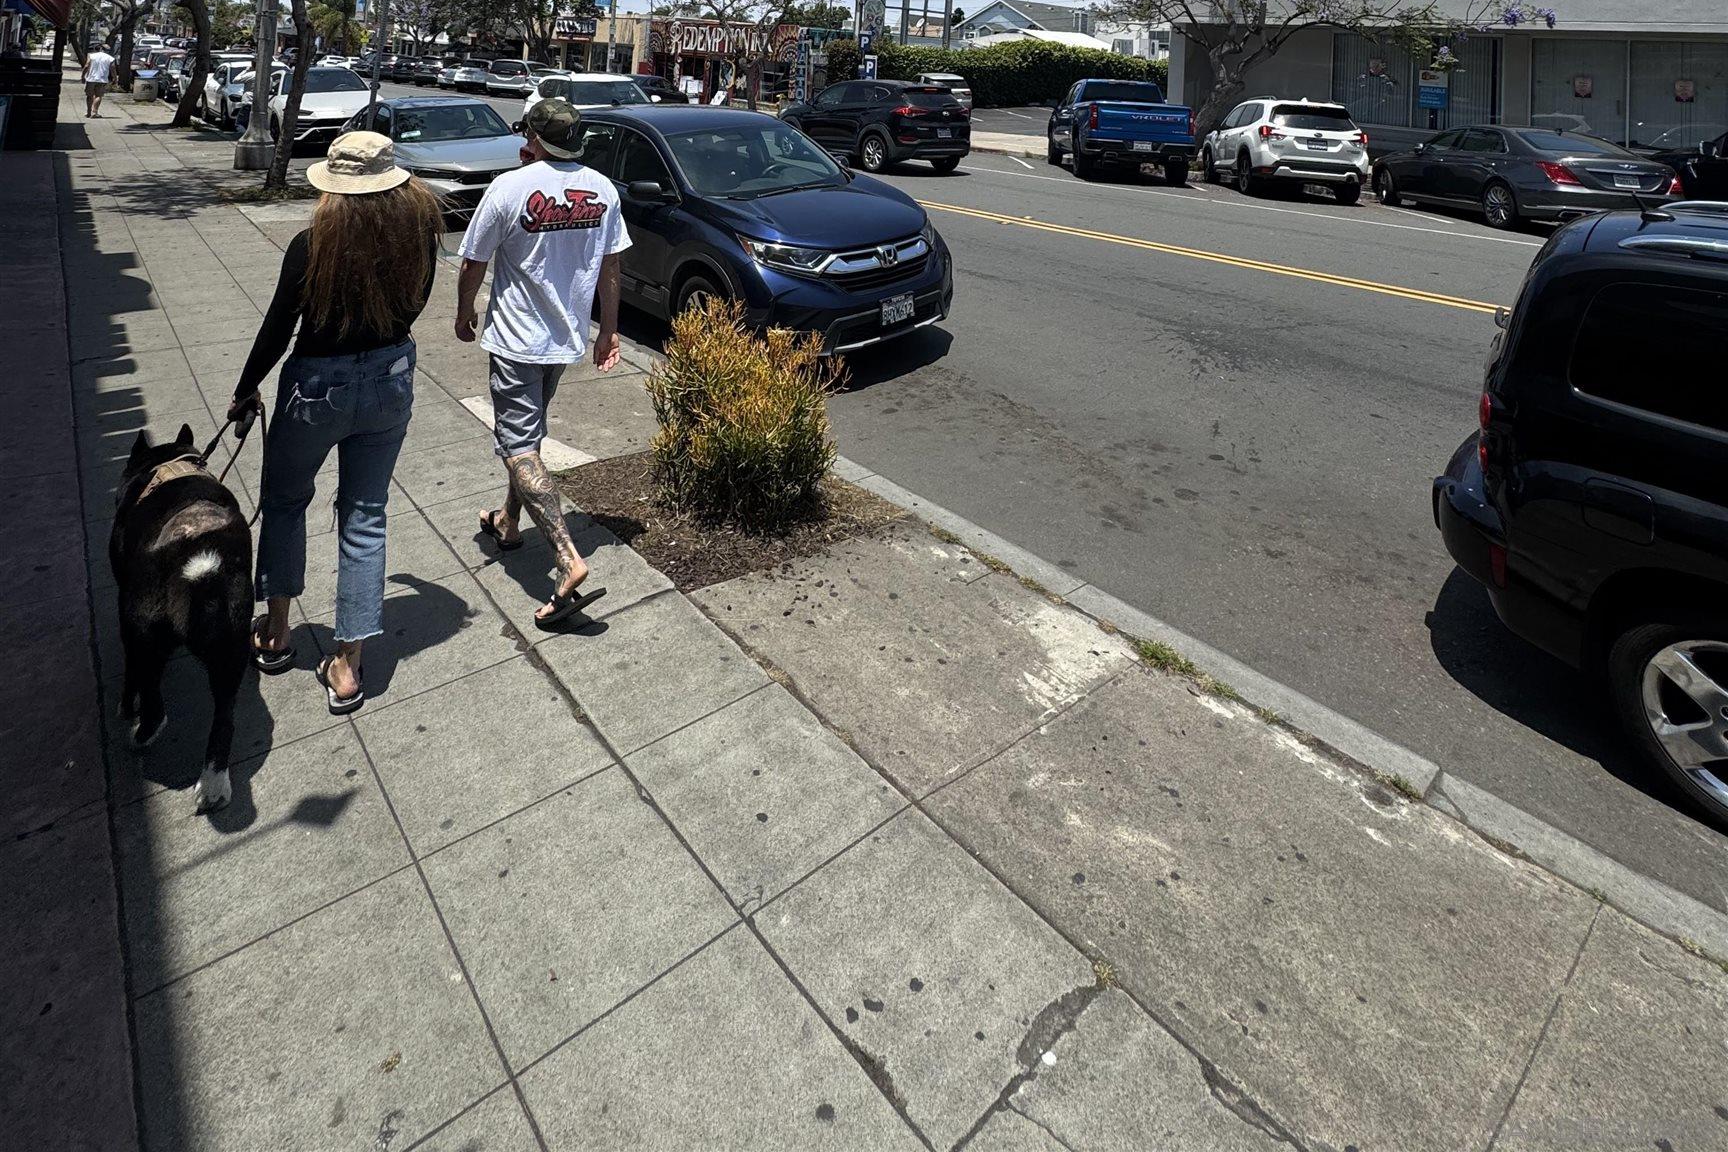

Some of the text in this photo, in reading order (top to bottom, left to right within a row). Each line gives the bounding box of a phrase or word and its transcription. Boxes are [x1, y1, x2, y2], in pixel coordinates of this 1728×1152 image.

[861, 37, 869, 48] P
[866, 61, 874, 73] P
[540, 221, 599, 230] HYDRAULICS
